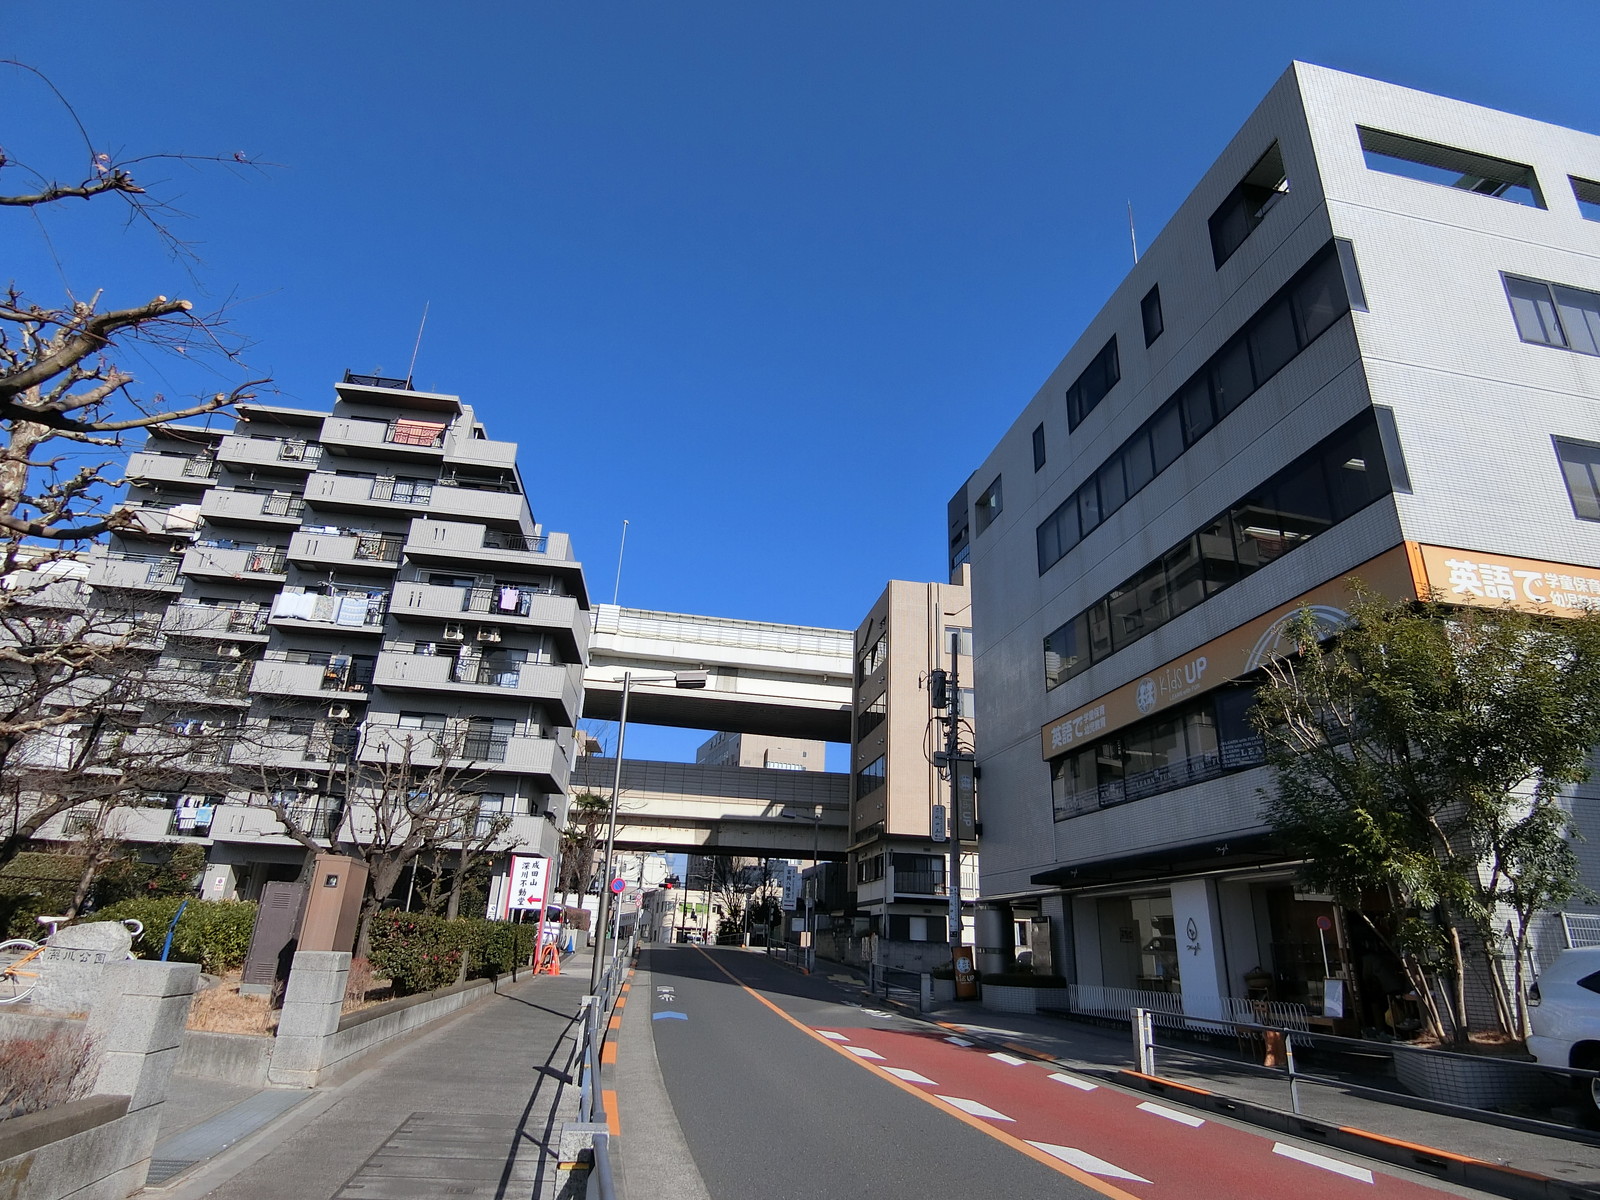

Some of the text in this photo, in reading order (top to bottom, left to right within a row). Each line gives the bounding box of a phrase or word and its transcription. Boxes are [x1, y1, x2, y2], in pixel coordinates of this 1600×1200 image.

[1445, 559, 1546, 602] 英語で
[1185, 657, 1207, 683] UP
[1051, 716, 1083, 749] 英語で
[517, 861, 530, 906] 深川不動堂
[530, 860, 540, 886] 成田山
[47, 949, 106, 964] 深川公園
